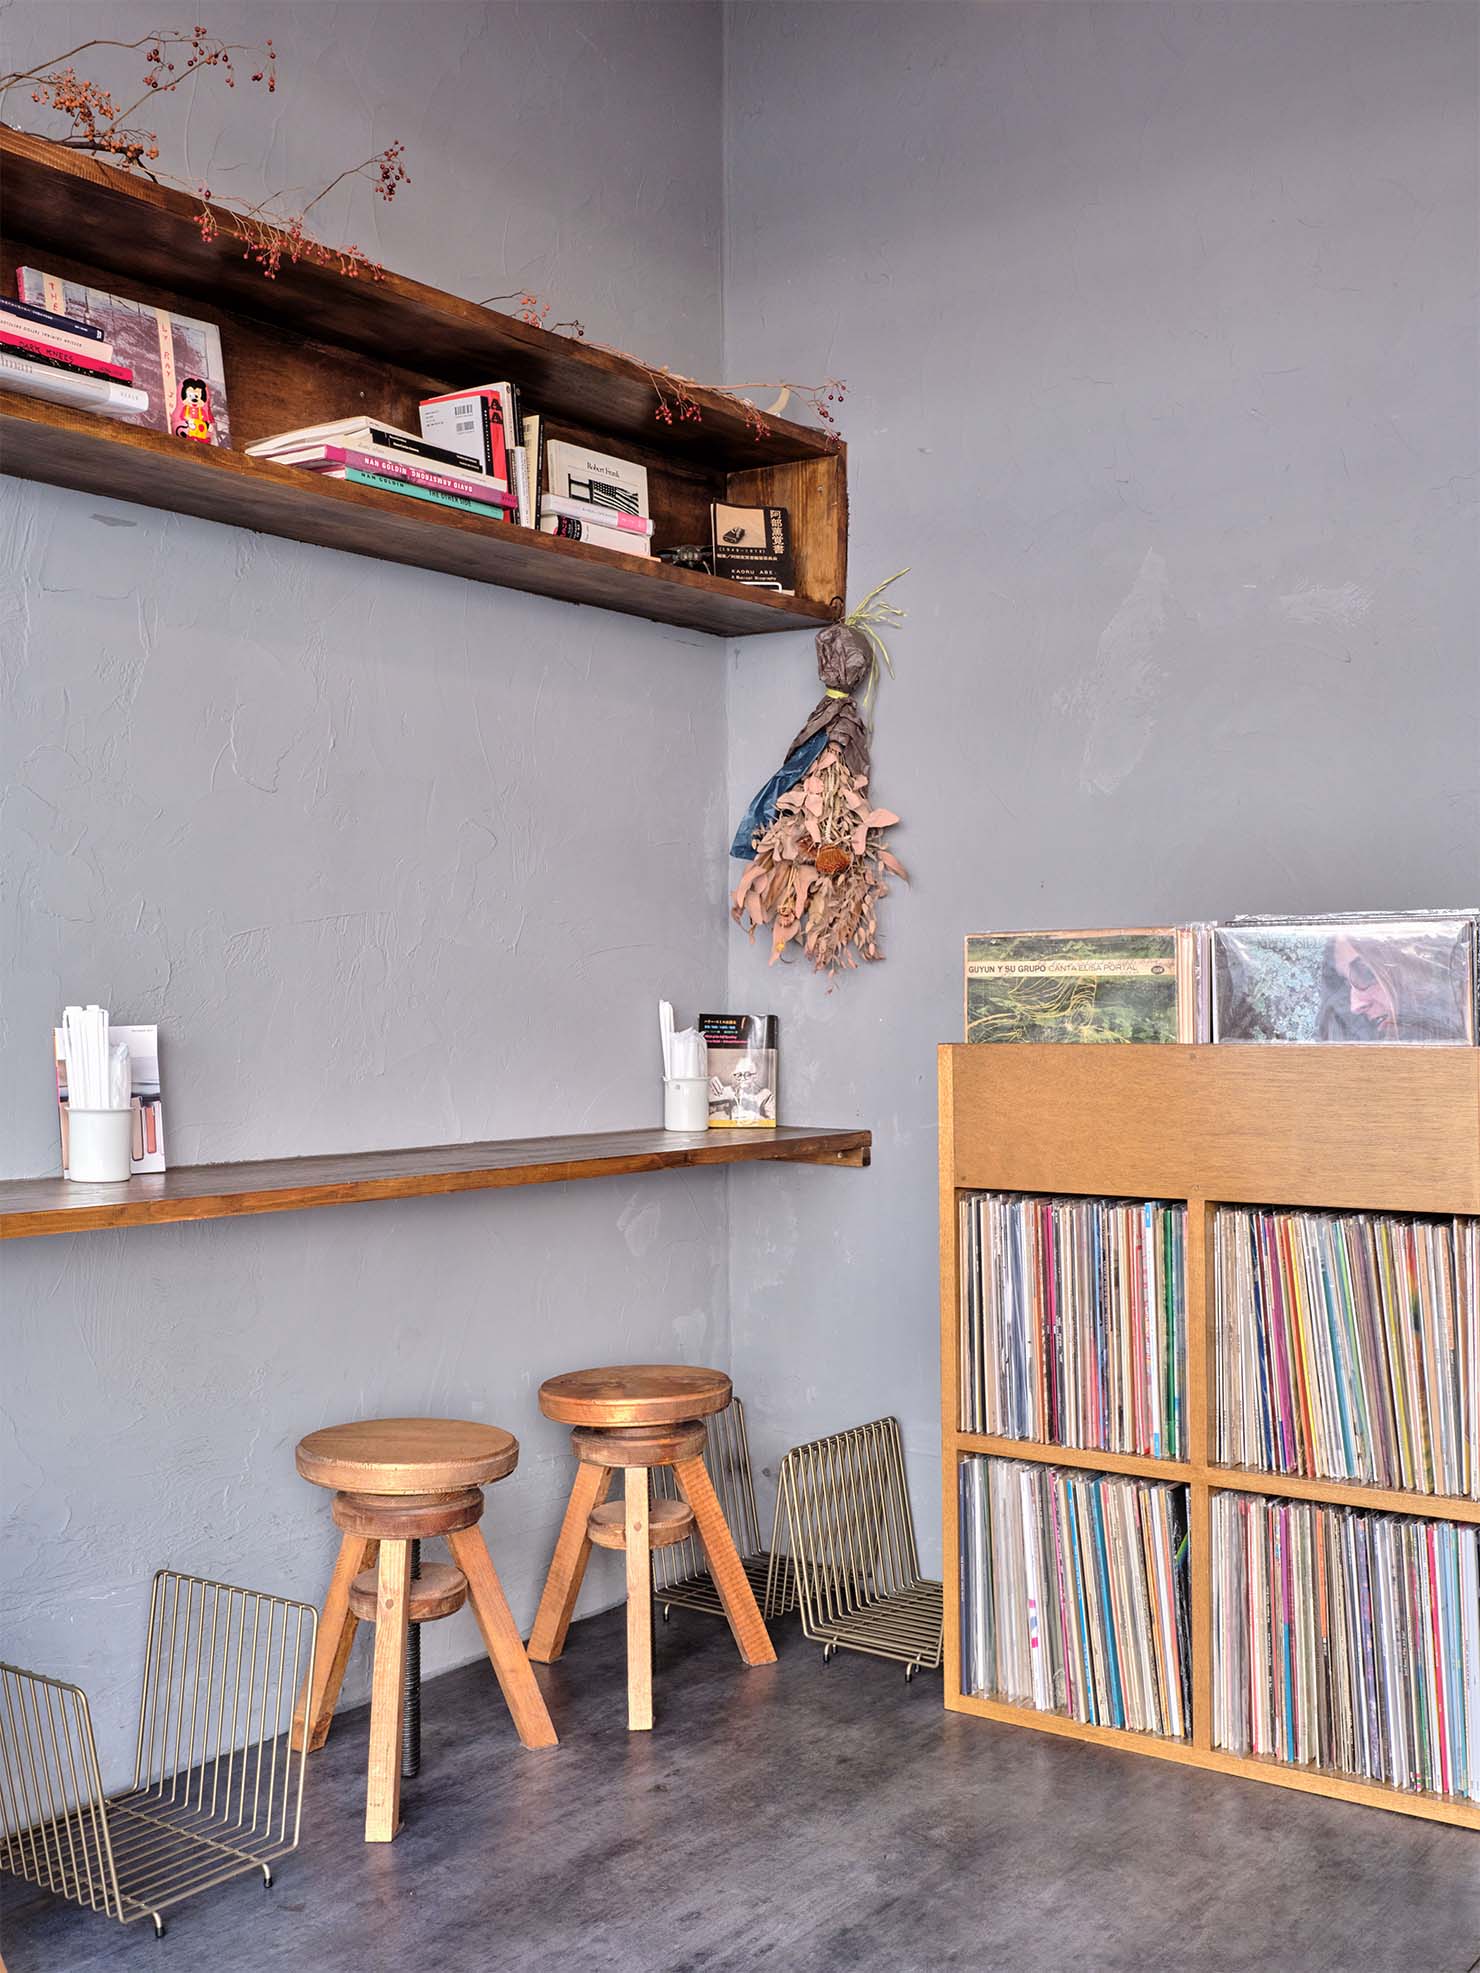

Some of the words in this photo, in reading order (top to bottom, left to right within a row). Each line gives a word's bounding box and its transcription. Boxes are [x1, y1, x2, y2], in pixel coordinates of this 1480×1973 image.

[364, 457, 380, 467] NAN
[382, 461, 408, 475] GOLDIN
[586, 461, 605, 476] Robert
[605, 466, 620, 478] Frank
[361, 472, 377, 480] NAN
[379, 477, 405, 487] GOLDIN
[411, 470, 452, 489] ARMSTRONG
[453, 480, 473, 493] DAVID
[428, 489, 440, 499] THE
[441, 492, 459, 504] OTHER
[459, 496, 472, 507] SIDE
[968, 965, 996, 974] GUYUN
[997, 965, 1003, 973] Y
[1004, 965, 1017, 973] SU
[1018, 964, 1047, 973] GRUPO
[1048, 964, 1079, 973] CANTA
[1103, 962, 1138, 972] PORTAL
